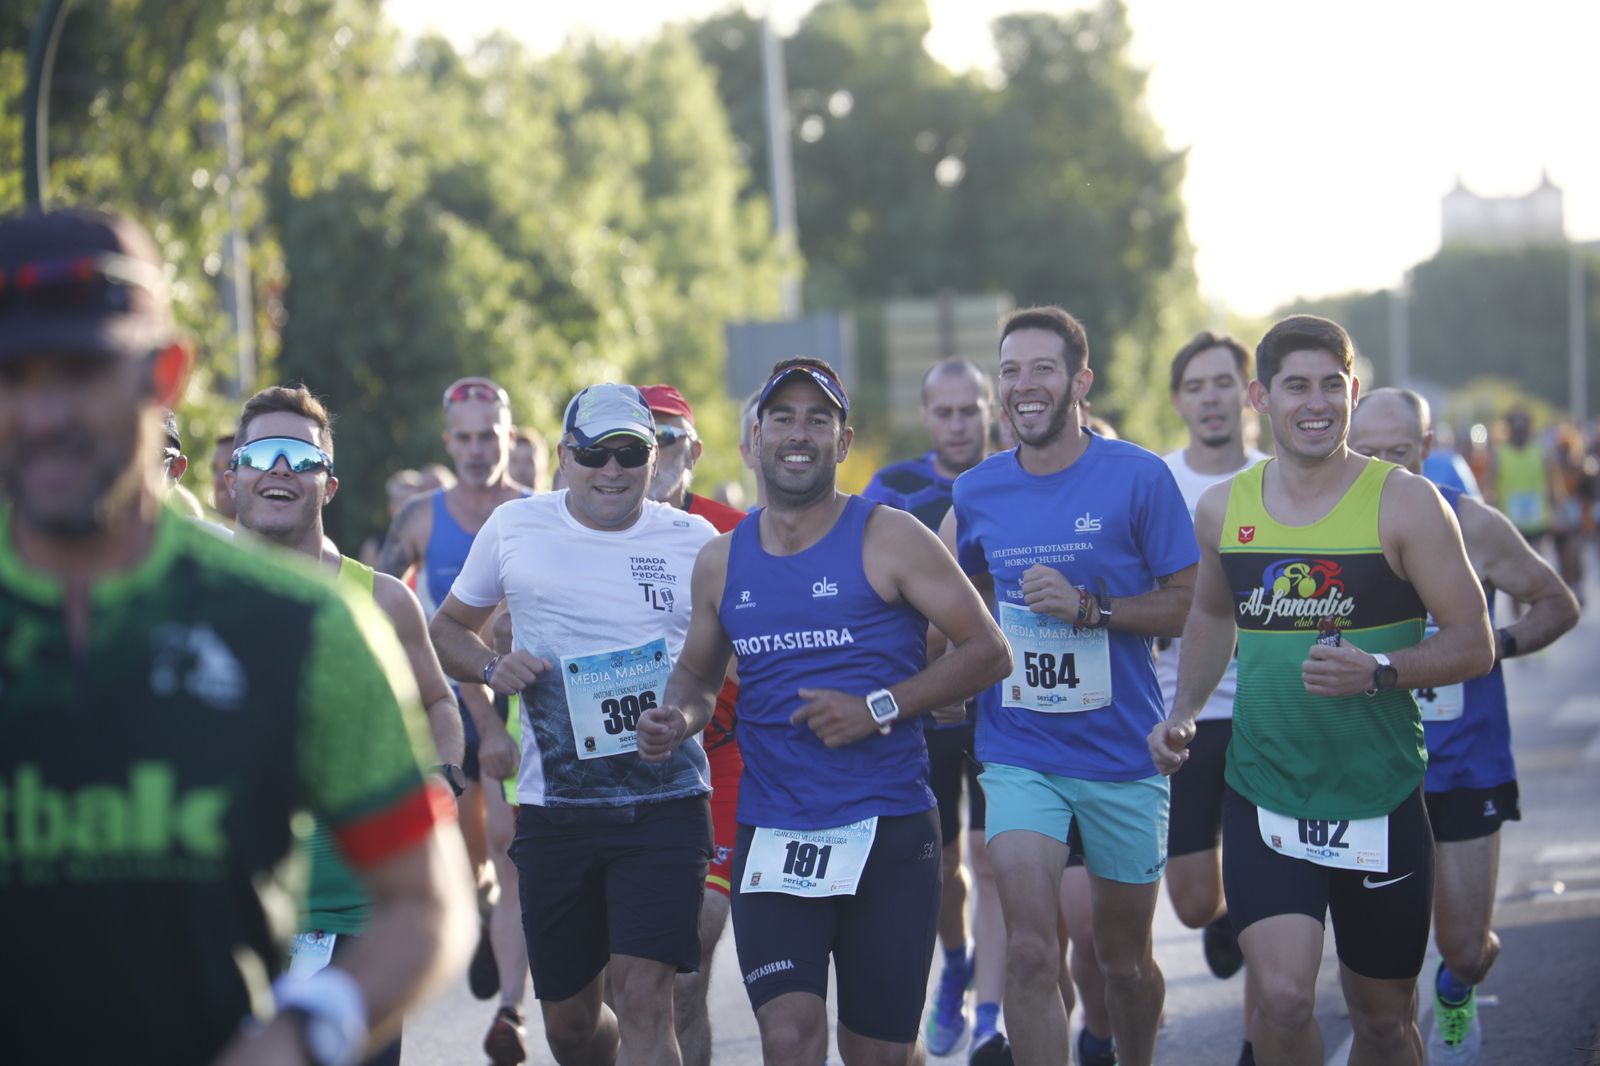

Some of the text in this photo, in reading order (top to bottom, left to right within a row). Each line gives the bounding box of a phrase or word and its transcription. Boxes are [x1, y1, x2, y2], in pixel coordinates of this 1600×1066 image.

[1033, 542, 1094, 554] TROTASIERRA
[629, 556, 667, 565] TIRADA
[1004, 554, 1075, 567] HORNACHUELOS
[631, 564, 665, 572] LARGA
[732, 627, 854, 656] TROTASIERRA
[1024, 651, 1080, 689] 584
[571, 671, 612, 686] MEDIA
[593, 687, 615, 700] ANTONIO
[783, 841, 832, 879] 191
